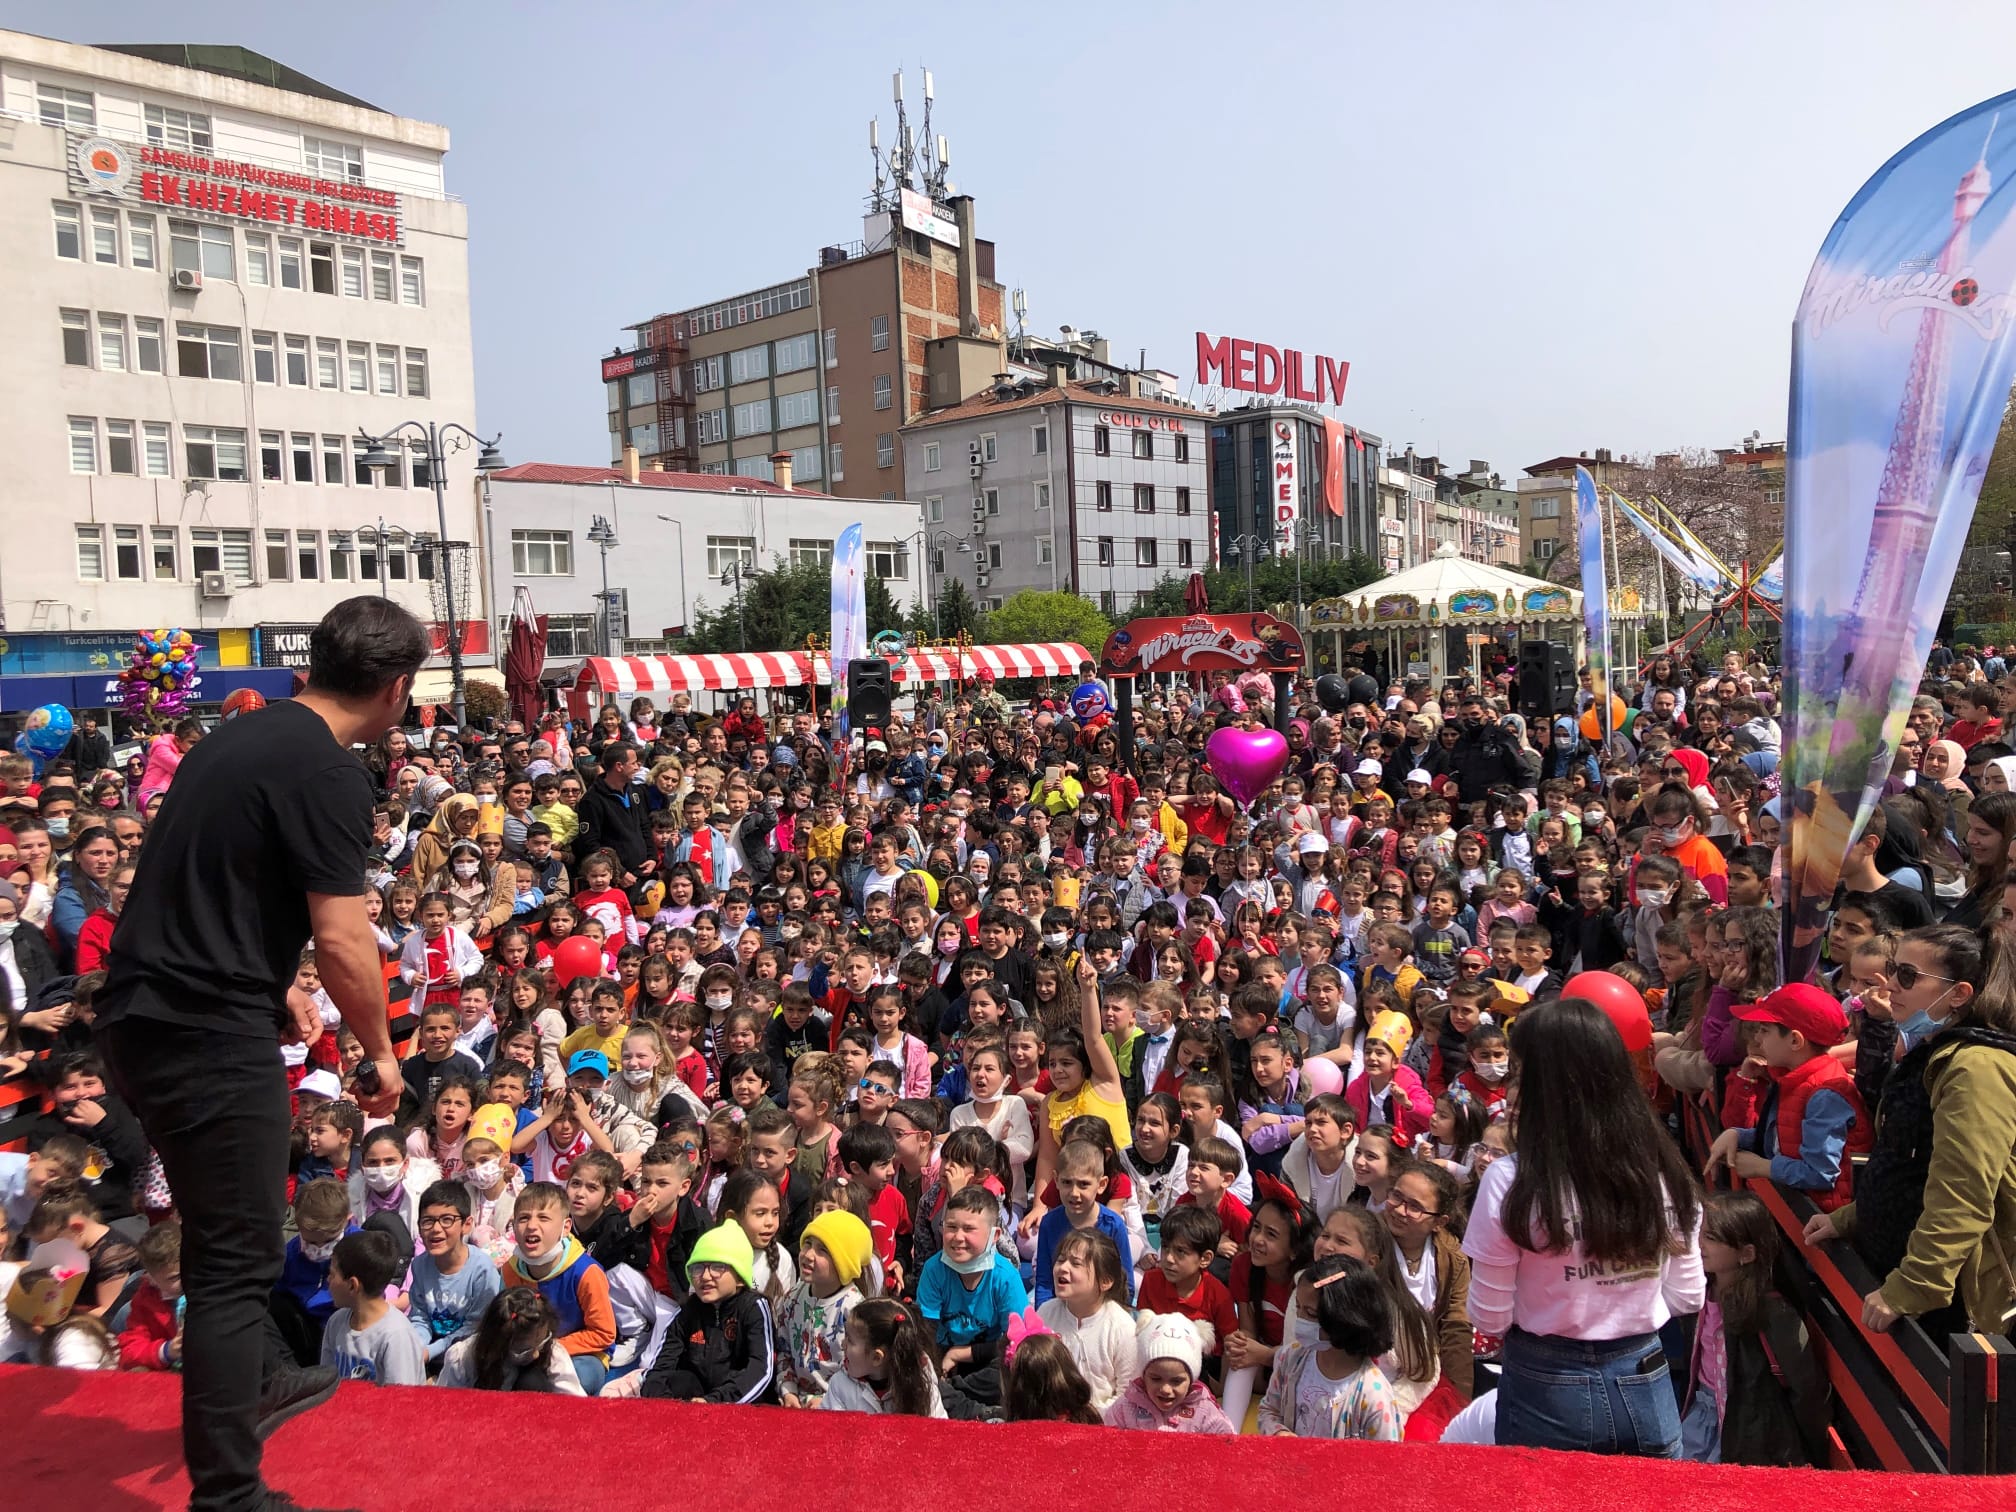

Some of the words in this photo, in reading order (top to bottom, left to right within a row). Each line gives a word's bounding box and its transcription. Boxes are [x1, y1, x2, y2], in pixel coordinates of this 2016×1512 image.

[140, 147, 210, 173] SAMSUN
[142, 171, 182, 205] EK
[1195, 331, 1350, 406] MEDILIV
[1099, 410, 1143, 428] GOLD
[1149, 416, 1184, 432] OTEL
[1564, 1261, 1604, 1282] FUN
